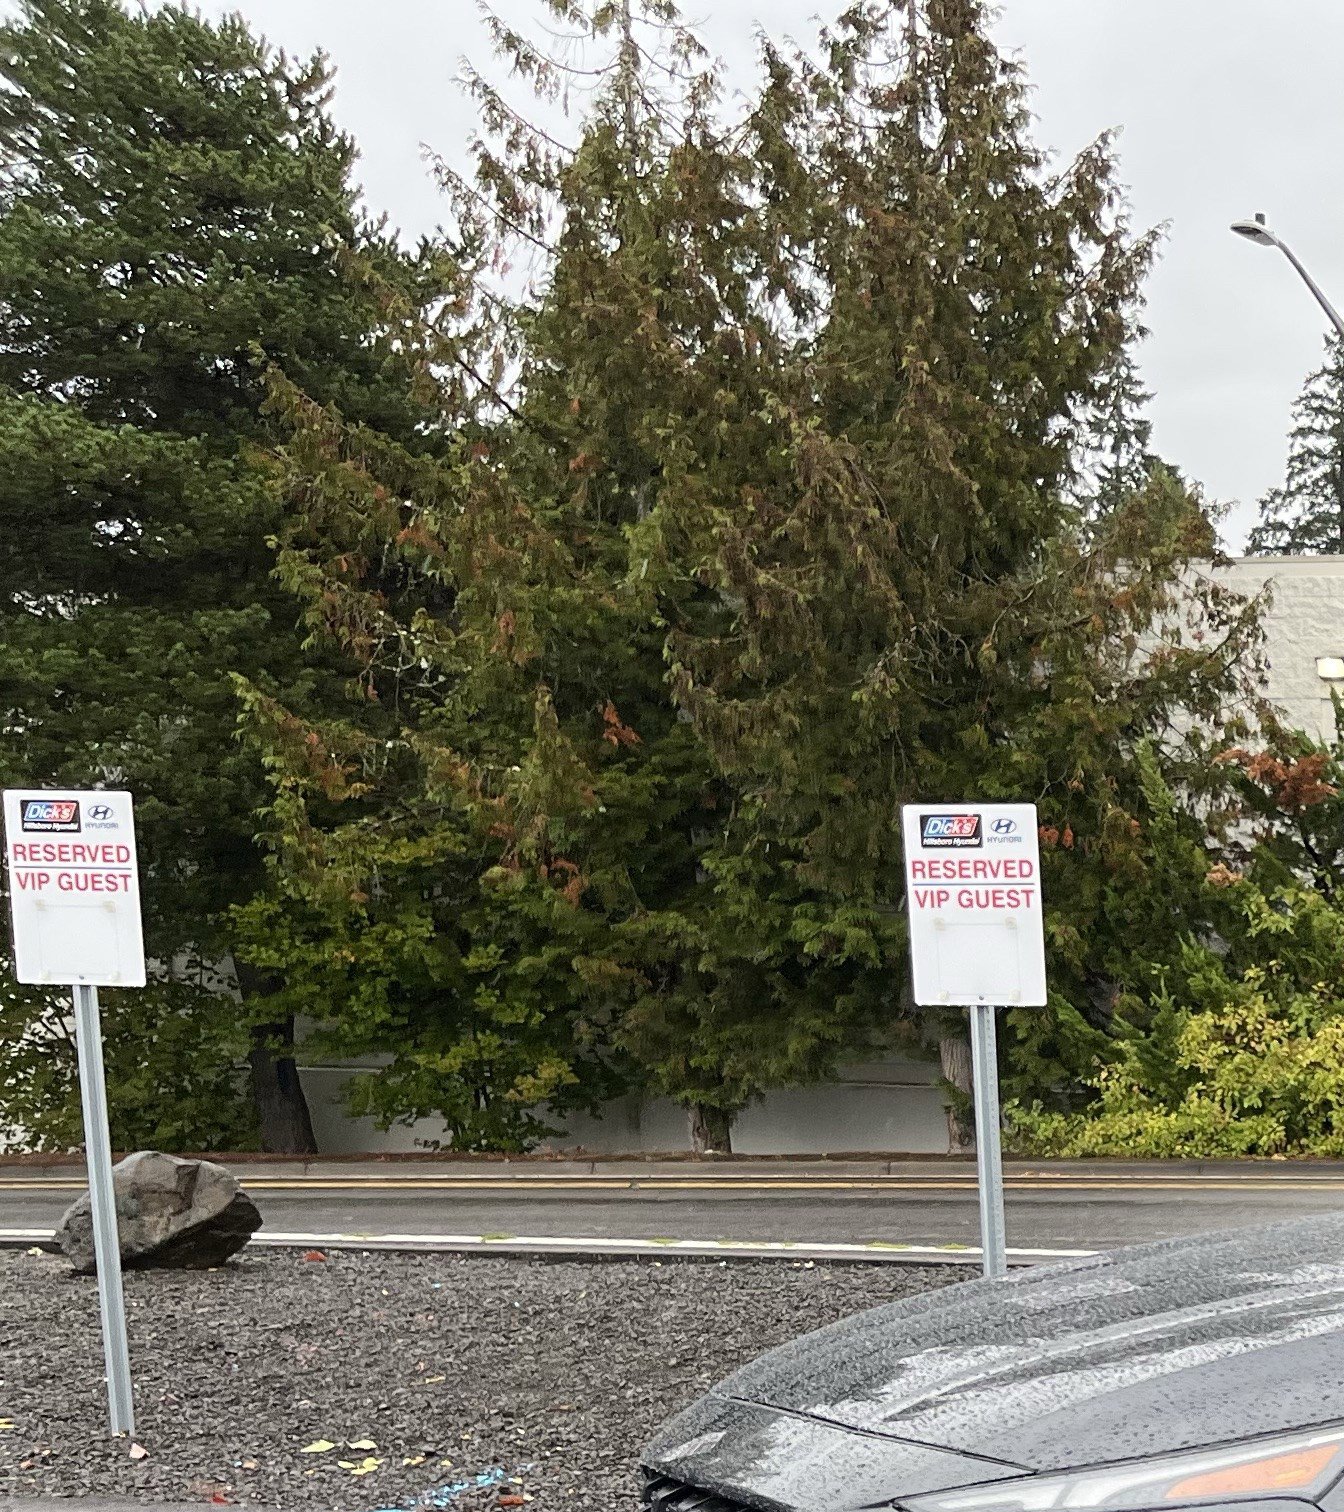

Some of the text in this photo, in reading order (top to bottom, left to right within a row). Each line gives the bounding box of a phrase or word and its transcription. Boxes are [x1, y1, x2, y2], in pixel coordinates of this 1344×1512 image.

[13, 843, 130, 863] RESERVED
[911, 859, 1034, 879] RESERVED
[17, 872, 132, 892] VIP GUEST
[914, 889, 1035, 909] VIP GUEST
